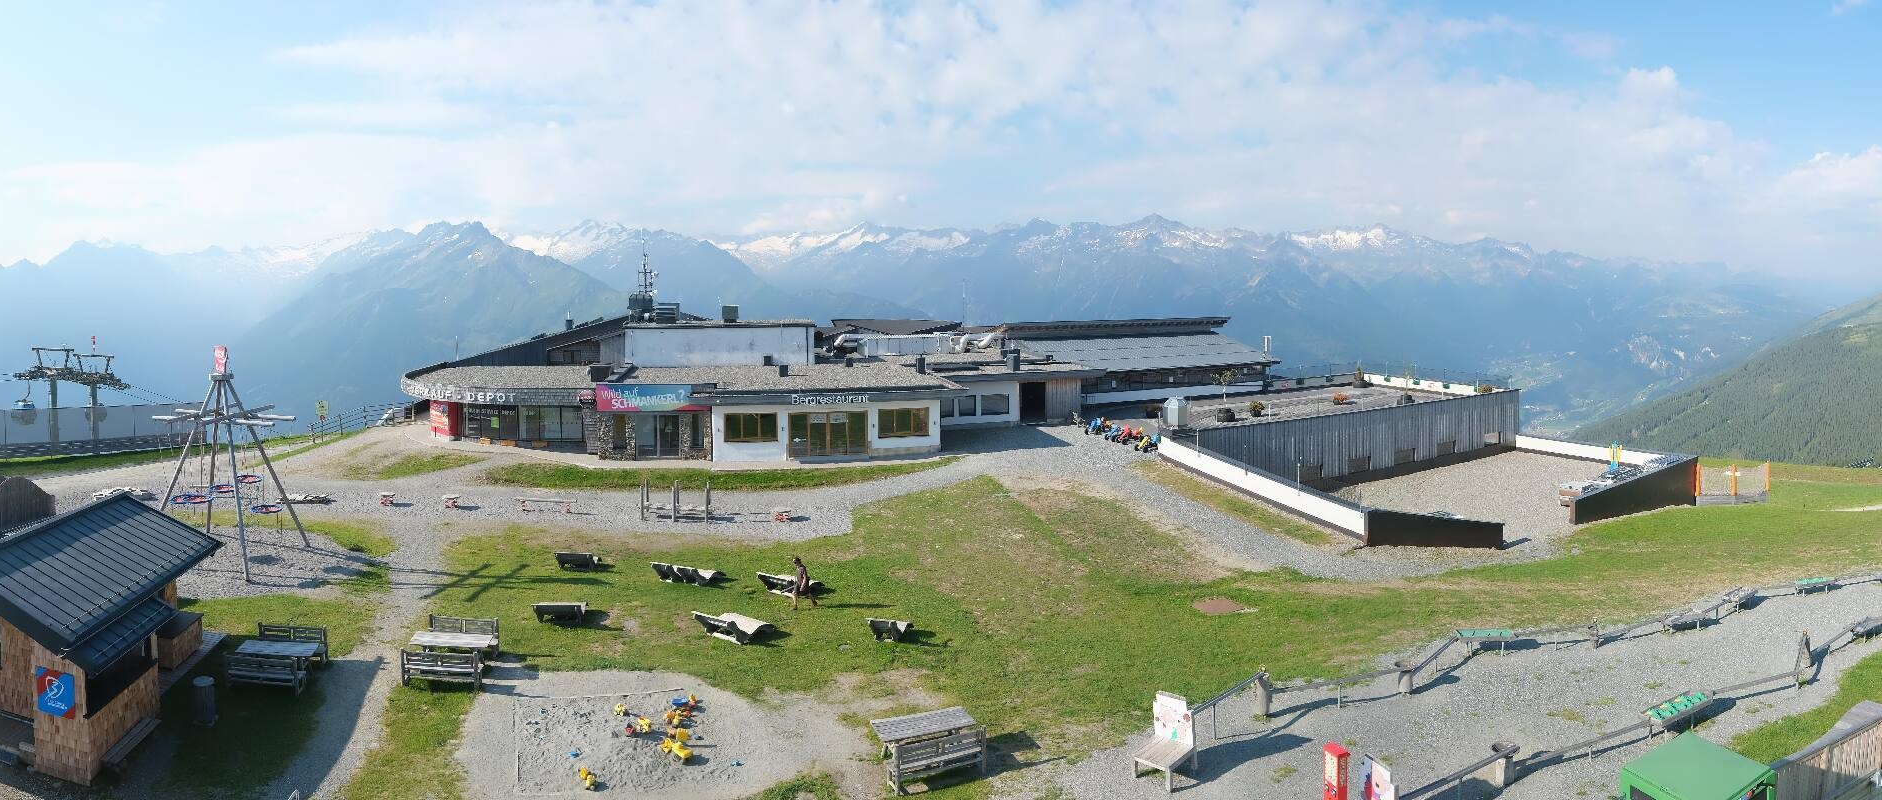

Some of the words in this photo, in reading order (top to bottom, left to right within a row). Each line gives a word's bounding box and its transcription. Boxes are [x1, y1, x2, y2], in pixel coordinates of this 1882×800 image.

[467, 392, 516, 402] DEPOT
[601, 389, 622, 399] Wild
[623, 386, 639, 398] auf
[611, 390, 685, 409] SCHMANKERL?
[791, 393, 869, 407] Bergrestaurant
